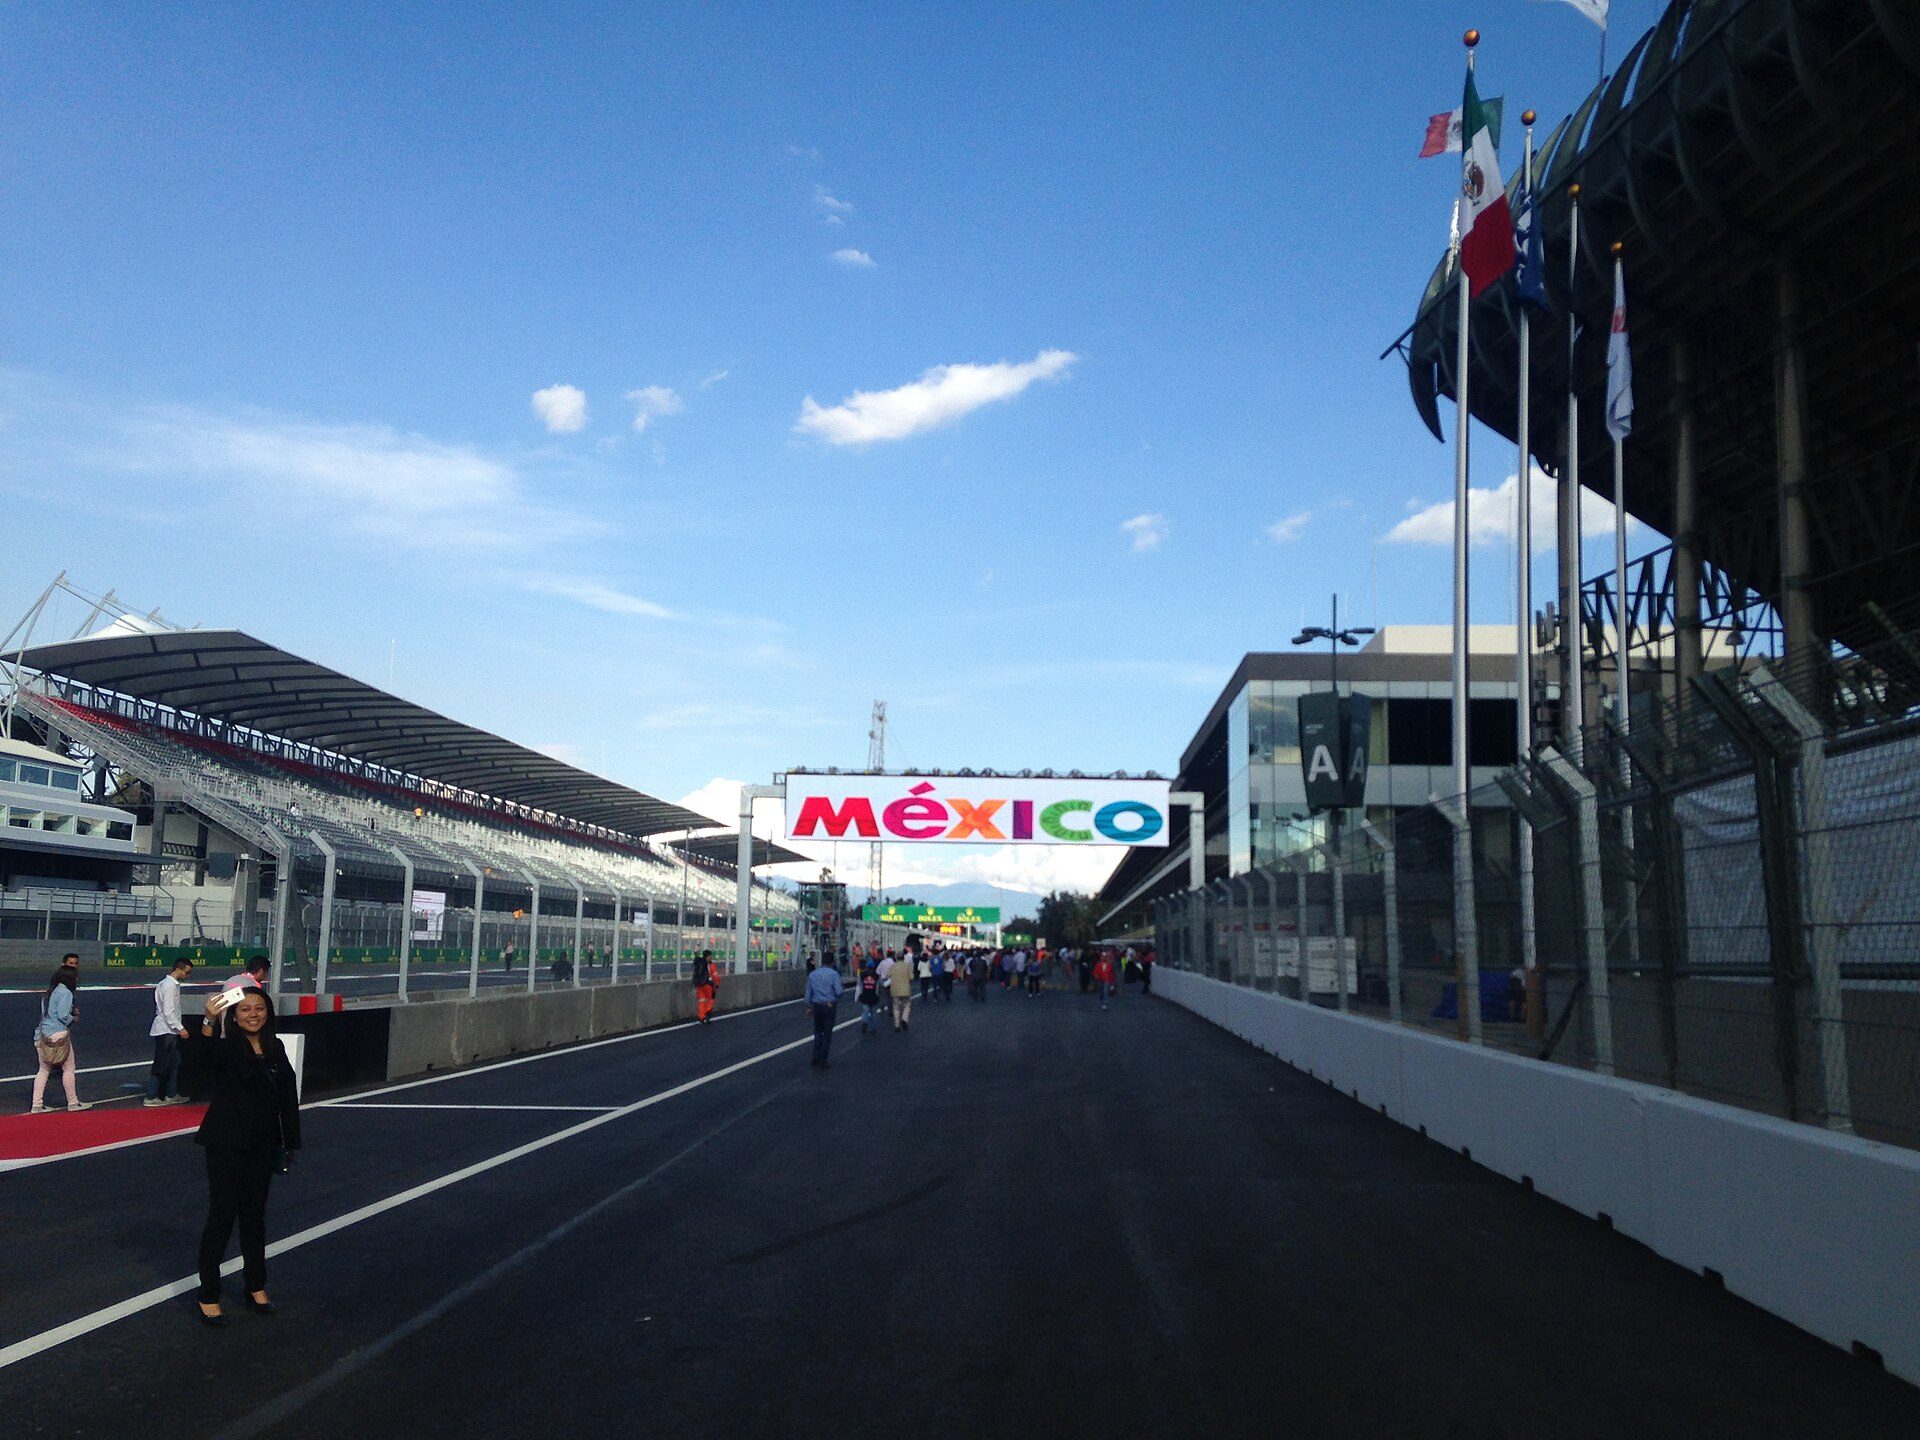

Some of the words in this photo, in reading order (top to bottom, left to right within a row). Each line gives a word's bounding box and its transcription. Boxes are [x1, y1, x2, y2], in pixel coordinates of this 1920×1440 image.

[1308, 744, 1339, 782] A
[1349, 746, 1367, 782] A
[107, 959, 126, 967] ROLEX
